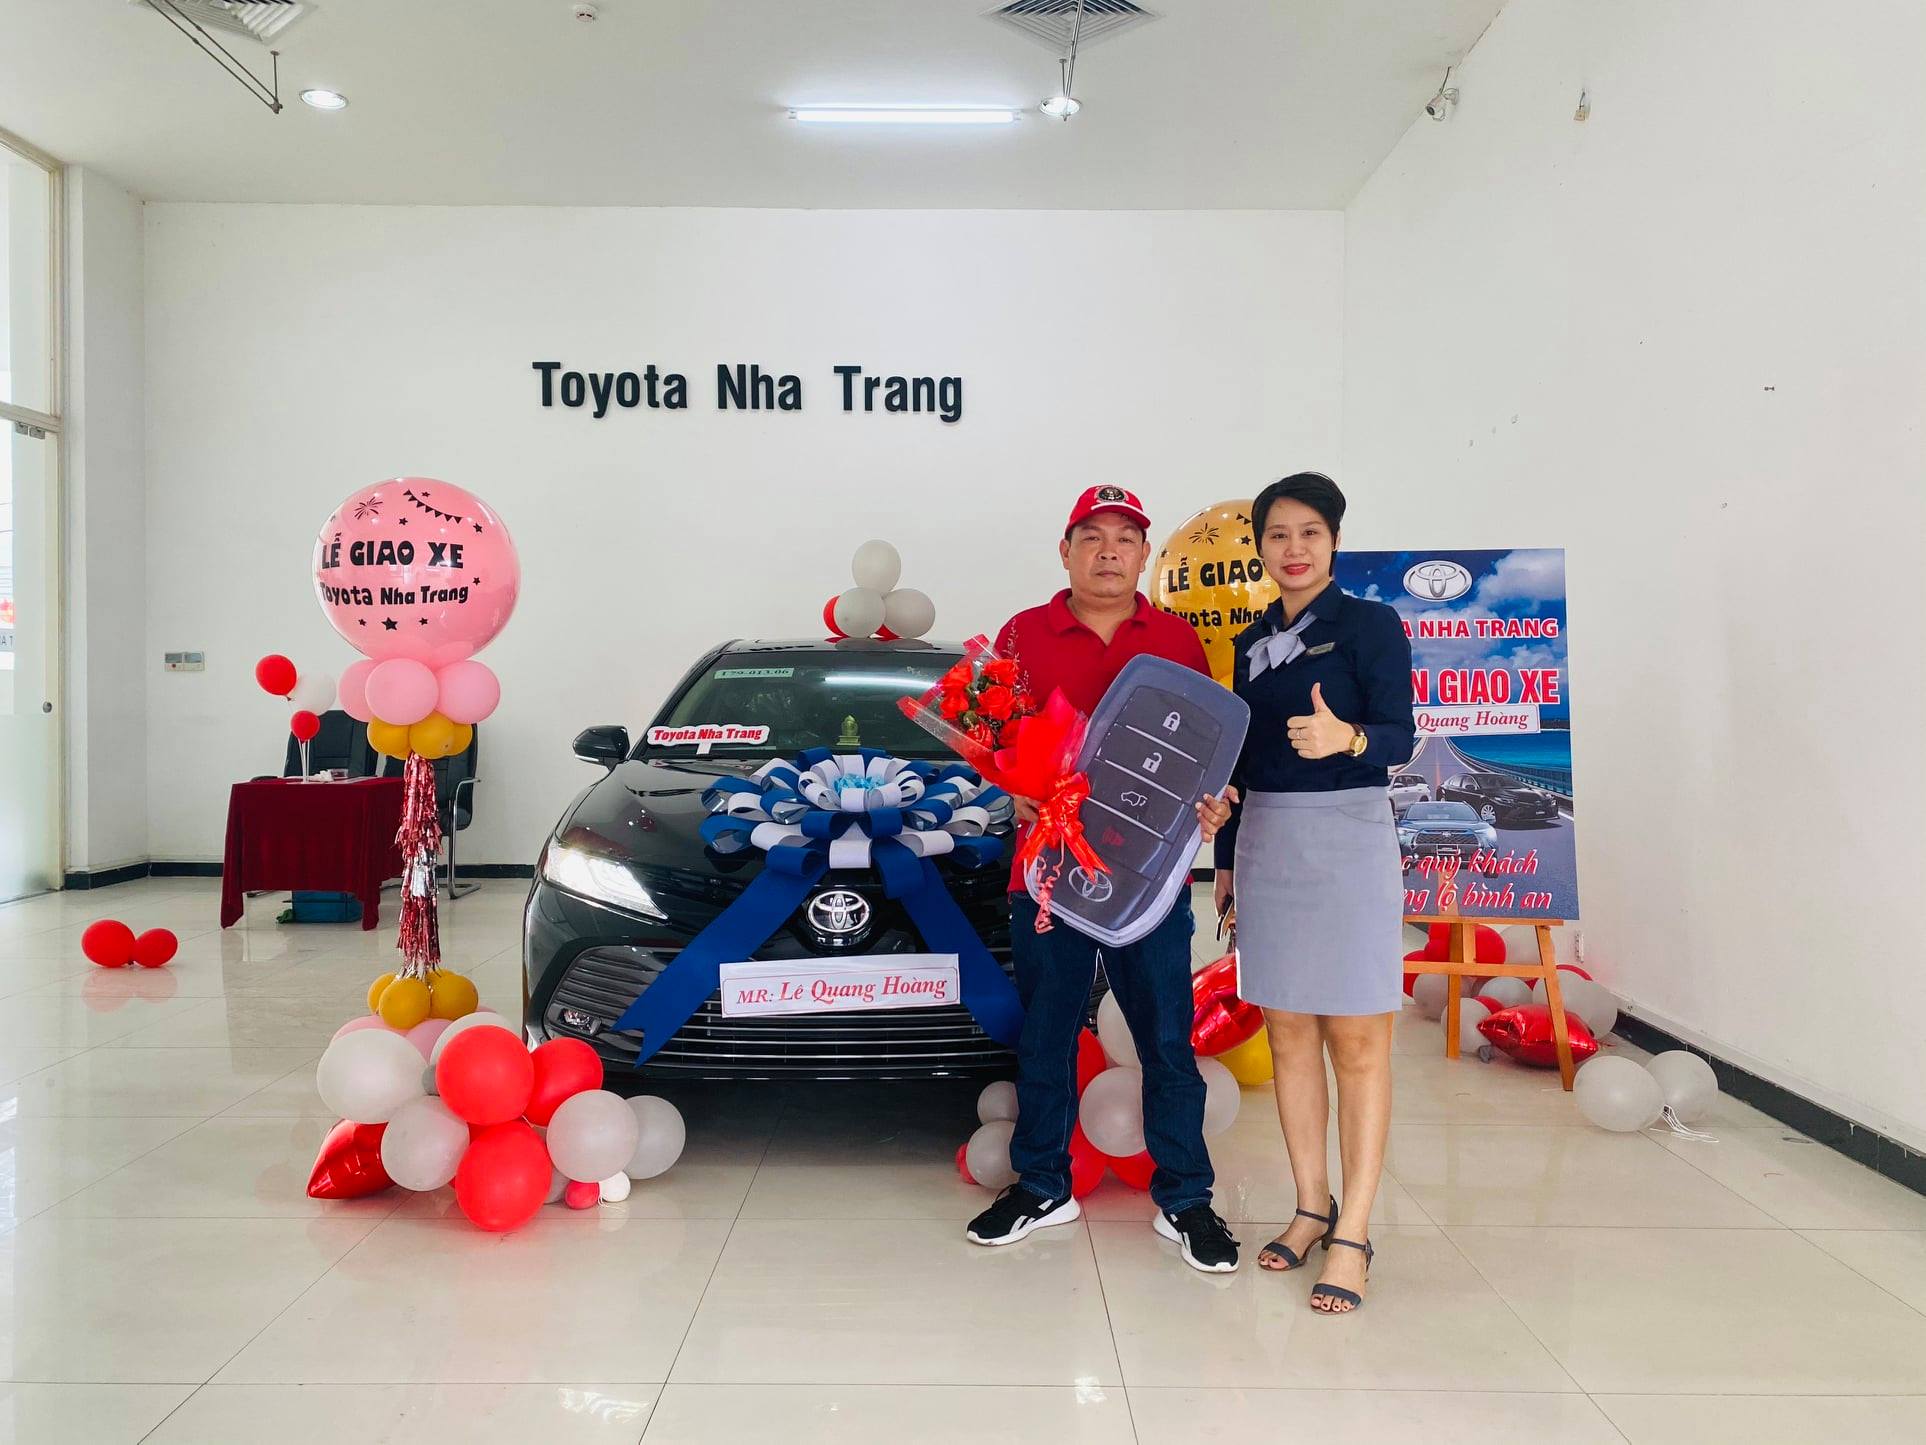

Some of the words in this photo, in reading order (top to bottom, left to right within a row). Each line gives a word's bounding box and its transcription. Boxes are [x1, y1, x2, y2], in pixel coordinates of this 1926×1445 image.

[532, 361, 688, 419] Toyota
[716, 363, 802, 411] Nha
[833, 365, 962, 424] Trang
[321, 532, 342, 569] LỄ
[350, 540, 415, 566] GIAO
[427, 541, 464, 569] XE
[1168, 556, 1190, 593] LỄ
[1200, 557, 1264, 588] GIAO
[320, 582, 373, 606] Toyota
[380, 585, 415, 605] Nha
[420, 585, 469, 604] Trang
[1229, 606, 1263, 625] Nha
[1419, 619, 1470, 638] NHA
[1475, 618, 1559, 638] TRANG
[1438, 668, 1511, 705] GIAO
[1519, 668, 1561, 704] XE
[654, 729, 696, 742] Toyota
[697, 728, 723, 740] Nha
[726, 728, 762, 741] Trang
[1417, 712, 1470, 732] Quang
[1475, 710, 1529, 730] Hoàng
[1417, 848, 1462, 880] quý
[1467, 848, 1539, 875] khách
[1462, 881, 1515, 909] bình
[1520, 891, 1553, 910] an
[779, 981, 804, 1001] Lê
[811, 978, 876, 1005] Quang
[881, 975, 948, 999] Hoàng
